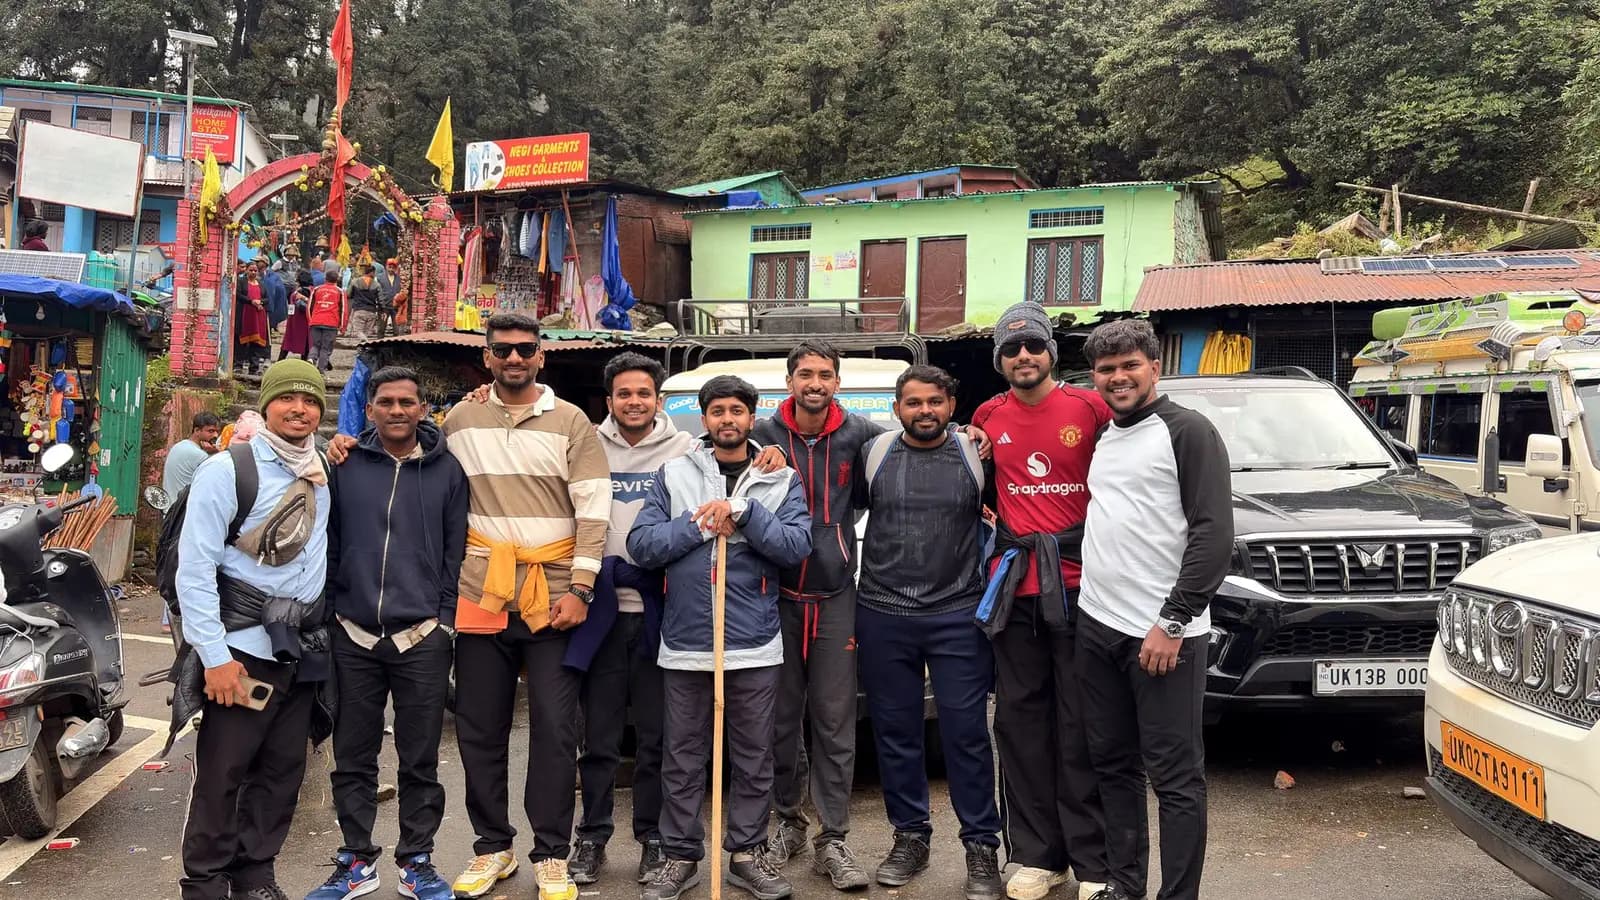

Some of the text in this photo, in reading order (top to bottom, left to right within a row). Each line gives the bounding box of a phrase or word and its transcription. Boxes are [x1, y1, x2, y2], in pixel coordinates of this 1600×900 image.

[195, 118, 227, 128] HOME
[197, 125, 224, 135] STAY
[509, 140, 581, 158] NEGI GARMENTS
[504, 159, 584, 178] SHOES COLLECTION
[611, 479, 655, 492] evi's
[1007, 481, 1085, 497] Snapdragon
[1330, 667, 1428, 686] UK13B 000
[1449, 734, 1539, 808] UK02TA9111
